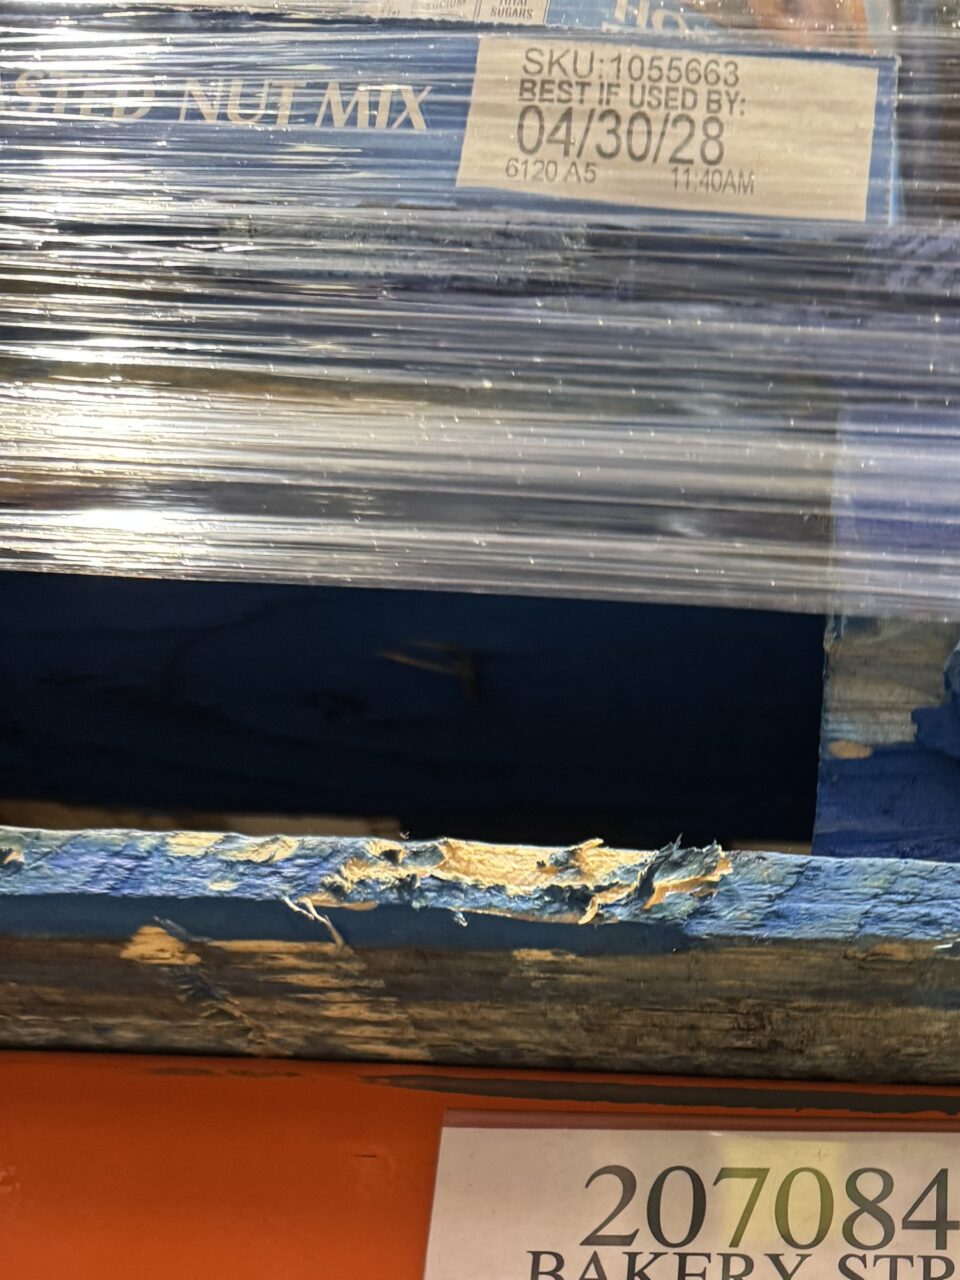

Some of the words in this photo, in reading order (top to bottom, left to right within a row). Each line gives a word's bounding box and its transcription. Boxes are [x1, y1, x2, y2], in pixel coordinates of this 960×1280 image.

[522, 47, 741, 87] SKU:1055663
[178, 77, 308, 127] NUT
[314, 80, 434, 131] MIX
[518, 79, 592, 105] BEST
[599, 84, 621, 107] IF
[629, 86, 699, 111] USED
[706, 89, 747, 117] BY:
[515, 104, 726, 167] 04/30/28
[504, 157, 559, 183] 6120
[562, 161, 598, 184] A5
[670, 166, 755, 195] 11:40AM
